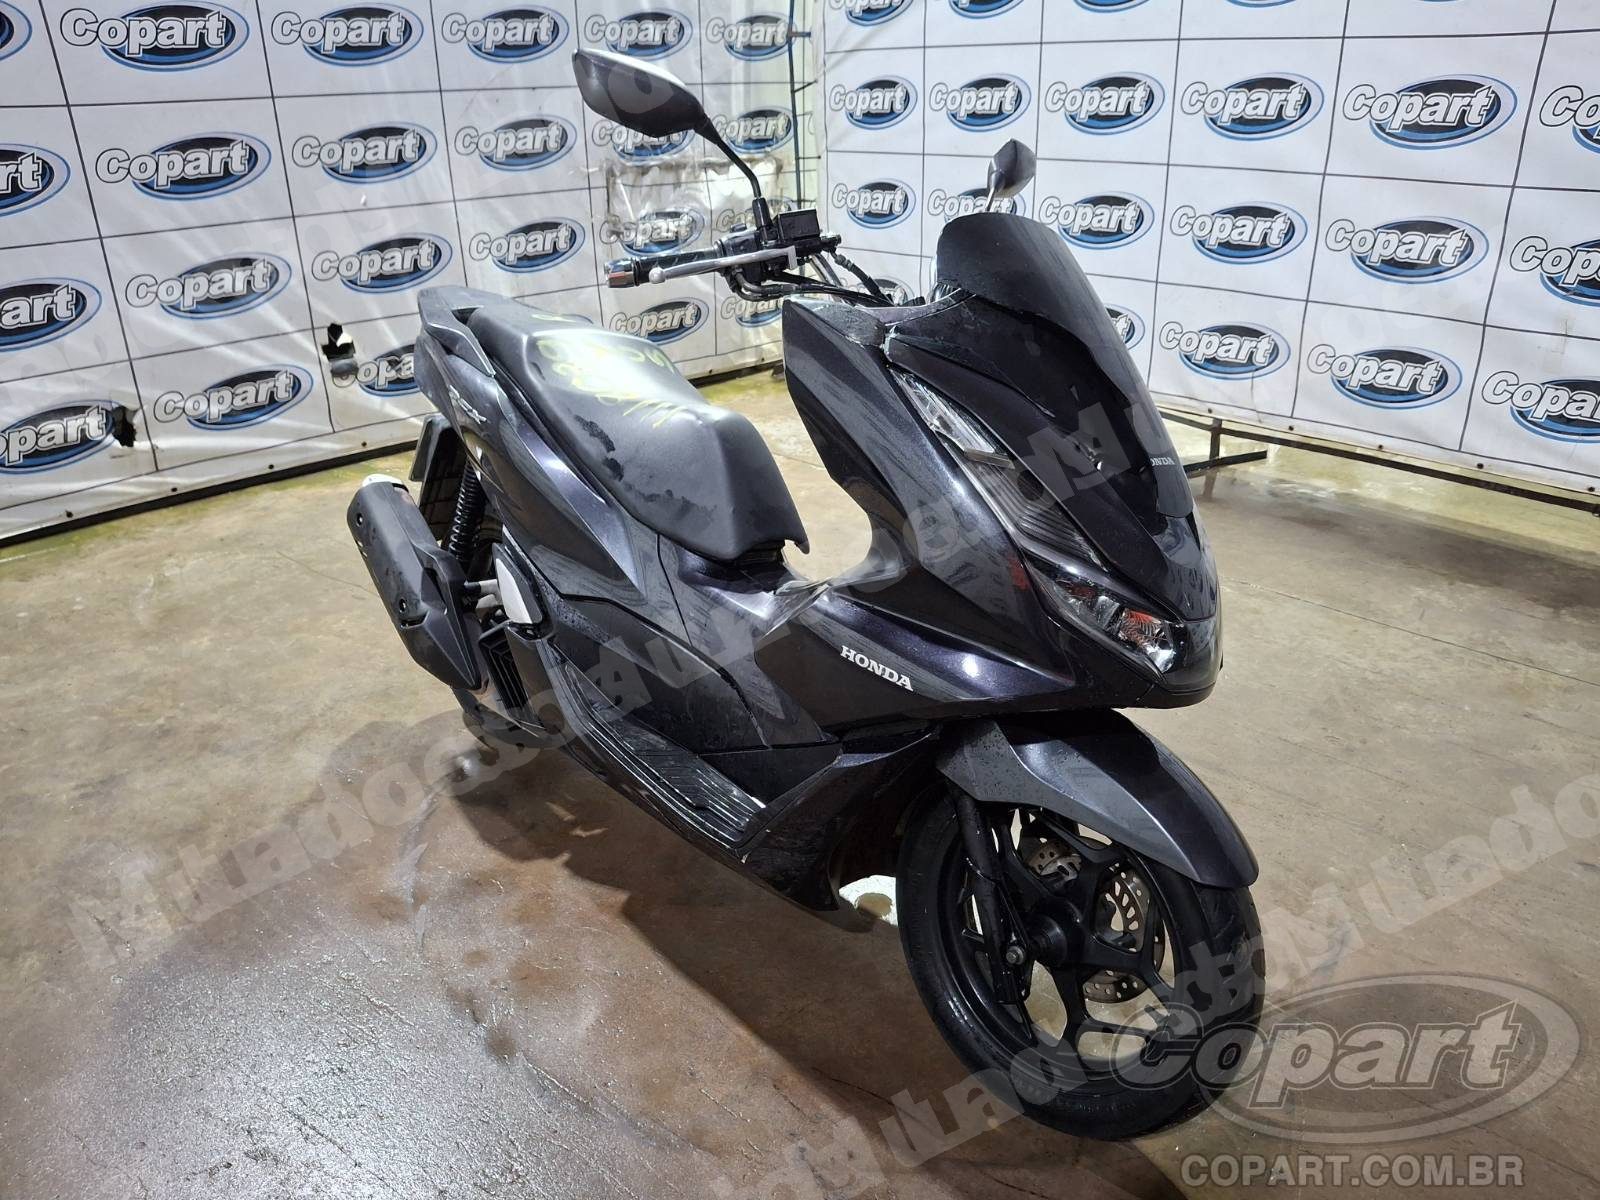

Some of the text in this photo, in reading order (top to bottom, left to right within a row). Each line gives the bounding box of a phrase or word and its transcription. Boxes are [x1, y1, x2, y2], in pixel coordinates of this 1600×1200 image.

[60, 8, 226, 56] Copart
[271, 11, 405, 54] Copart
[442, 13, 554, 52] Copart
[584, 15, 679, 48] Copart
[706, 17, 787, 49] Copart
[830, 82, 906, 118] Copart
[930, 81, 1018, 120] Copart
[1046, 81, 1150, 121] Copart
[1181, 82, 1307, 124] Copart
[1343, 84, 1495, 131] Copart
[455, 121, 561, 162] Copart
[712, 113, 788, 145] Copart
[96, 140, 250, 189] Copart
[292, 129, 420, 174] Copart
[832, 183, 906, 217] Copart
[1039, 197, 1141, 236] Copart
[469, 224, 572, 266] Copart
[1170, 205, 1289, 248] Copart
[1326, 219, 1469, 265] Copart
[312, 239, 435, 285] Copart
[1510, 236, 1600, 286] Cop
[125, 257, 272, 310] Copart
[610, 300, 700, 337] Copart
[1159, 321, 1278, 367] Copart
[1307, 344, 1443, 395] Copart
[154, 369, 294, 423] Copart
[840, 645, 913, 691] HONDA
